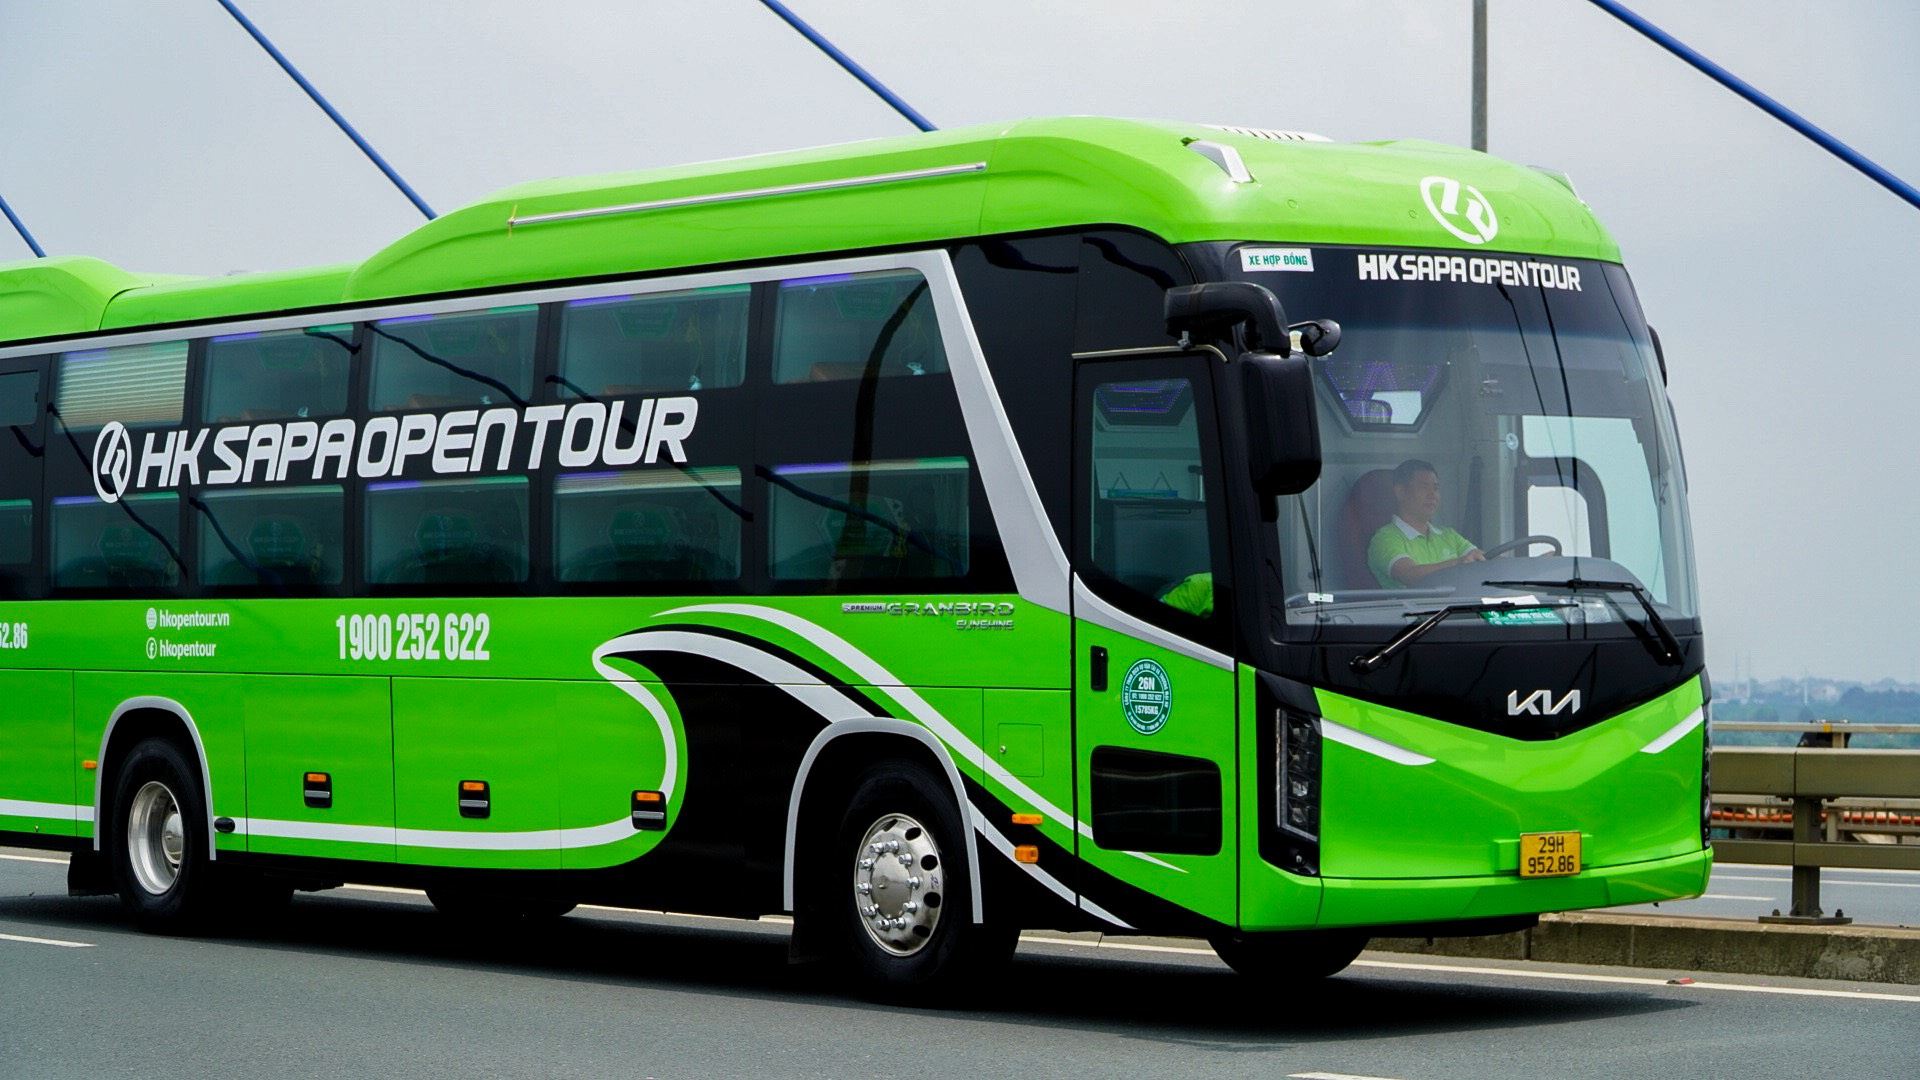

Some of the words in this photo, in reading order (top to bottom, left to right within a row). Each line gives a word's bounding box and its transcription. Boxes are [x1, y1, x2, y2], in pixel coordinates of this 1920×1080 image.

[1249, 255, 1260, 266] XE
[1358, 254, 1400, 280] HK
[1401, 255, 1467, 282] SAPA
[136, 428, 210, 488] HK
[206, 418, 356, 485] SAPA
[886, 602, 1015, 616] GRANBIRD
[160, 609, 230, 631] hkopentour.vn
[956, 619, 1015, 630] SUNSHINE
[0, 622, 28, 649] 2.86
[336, 614, 392, 661] 1900
[396, 613, 440, 660] 252
[444, 613, 490, 661] 622
[160, 639, 217, 660] hkopentour
[1138, 676, 1155, 690] 26N
[1507, 689, 1581, 716] KIA
[1539, 836, 1564, 853] 29H
[1528, 855, 1575, 874] 952.86
